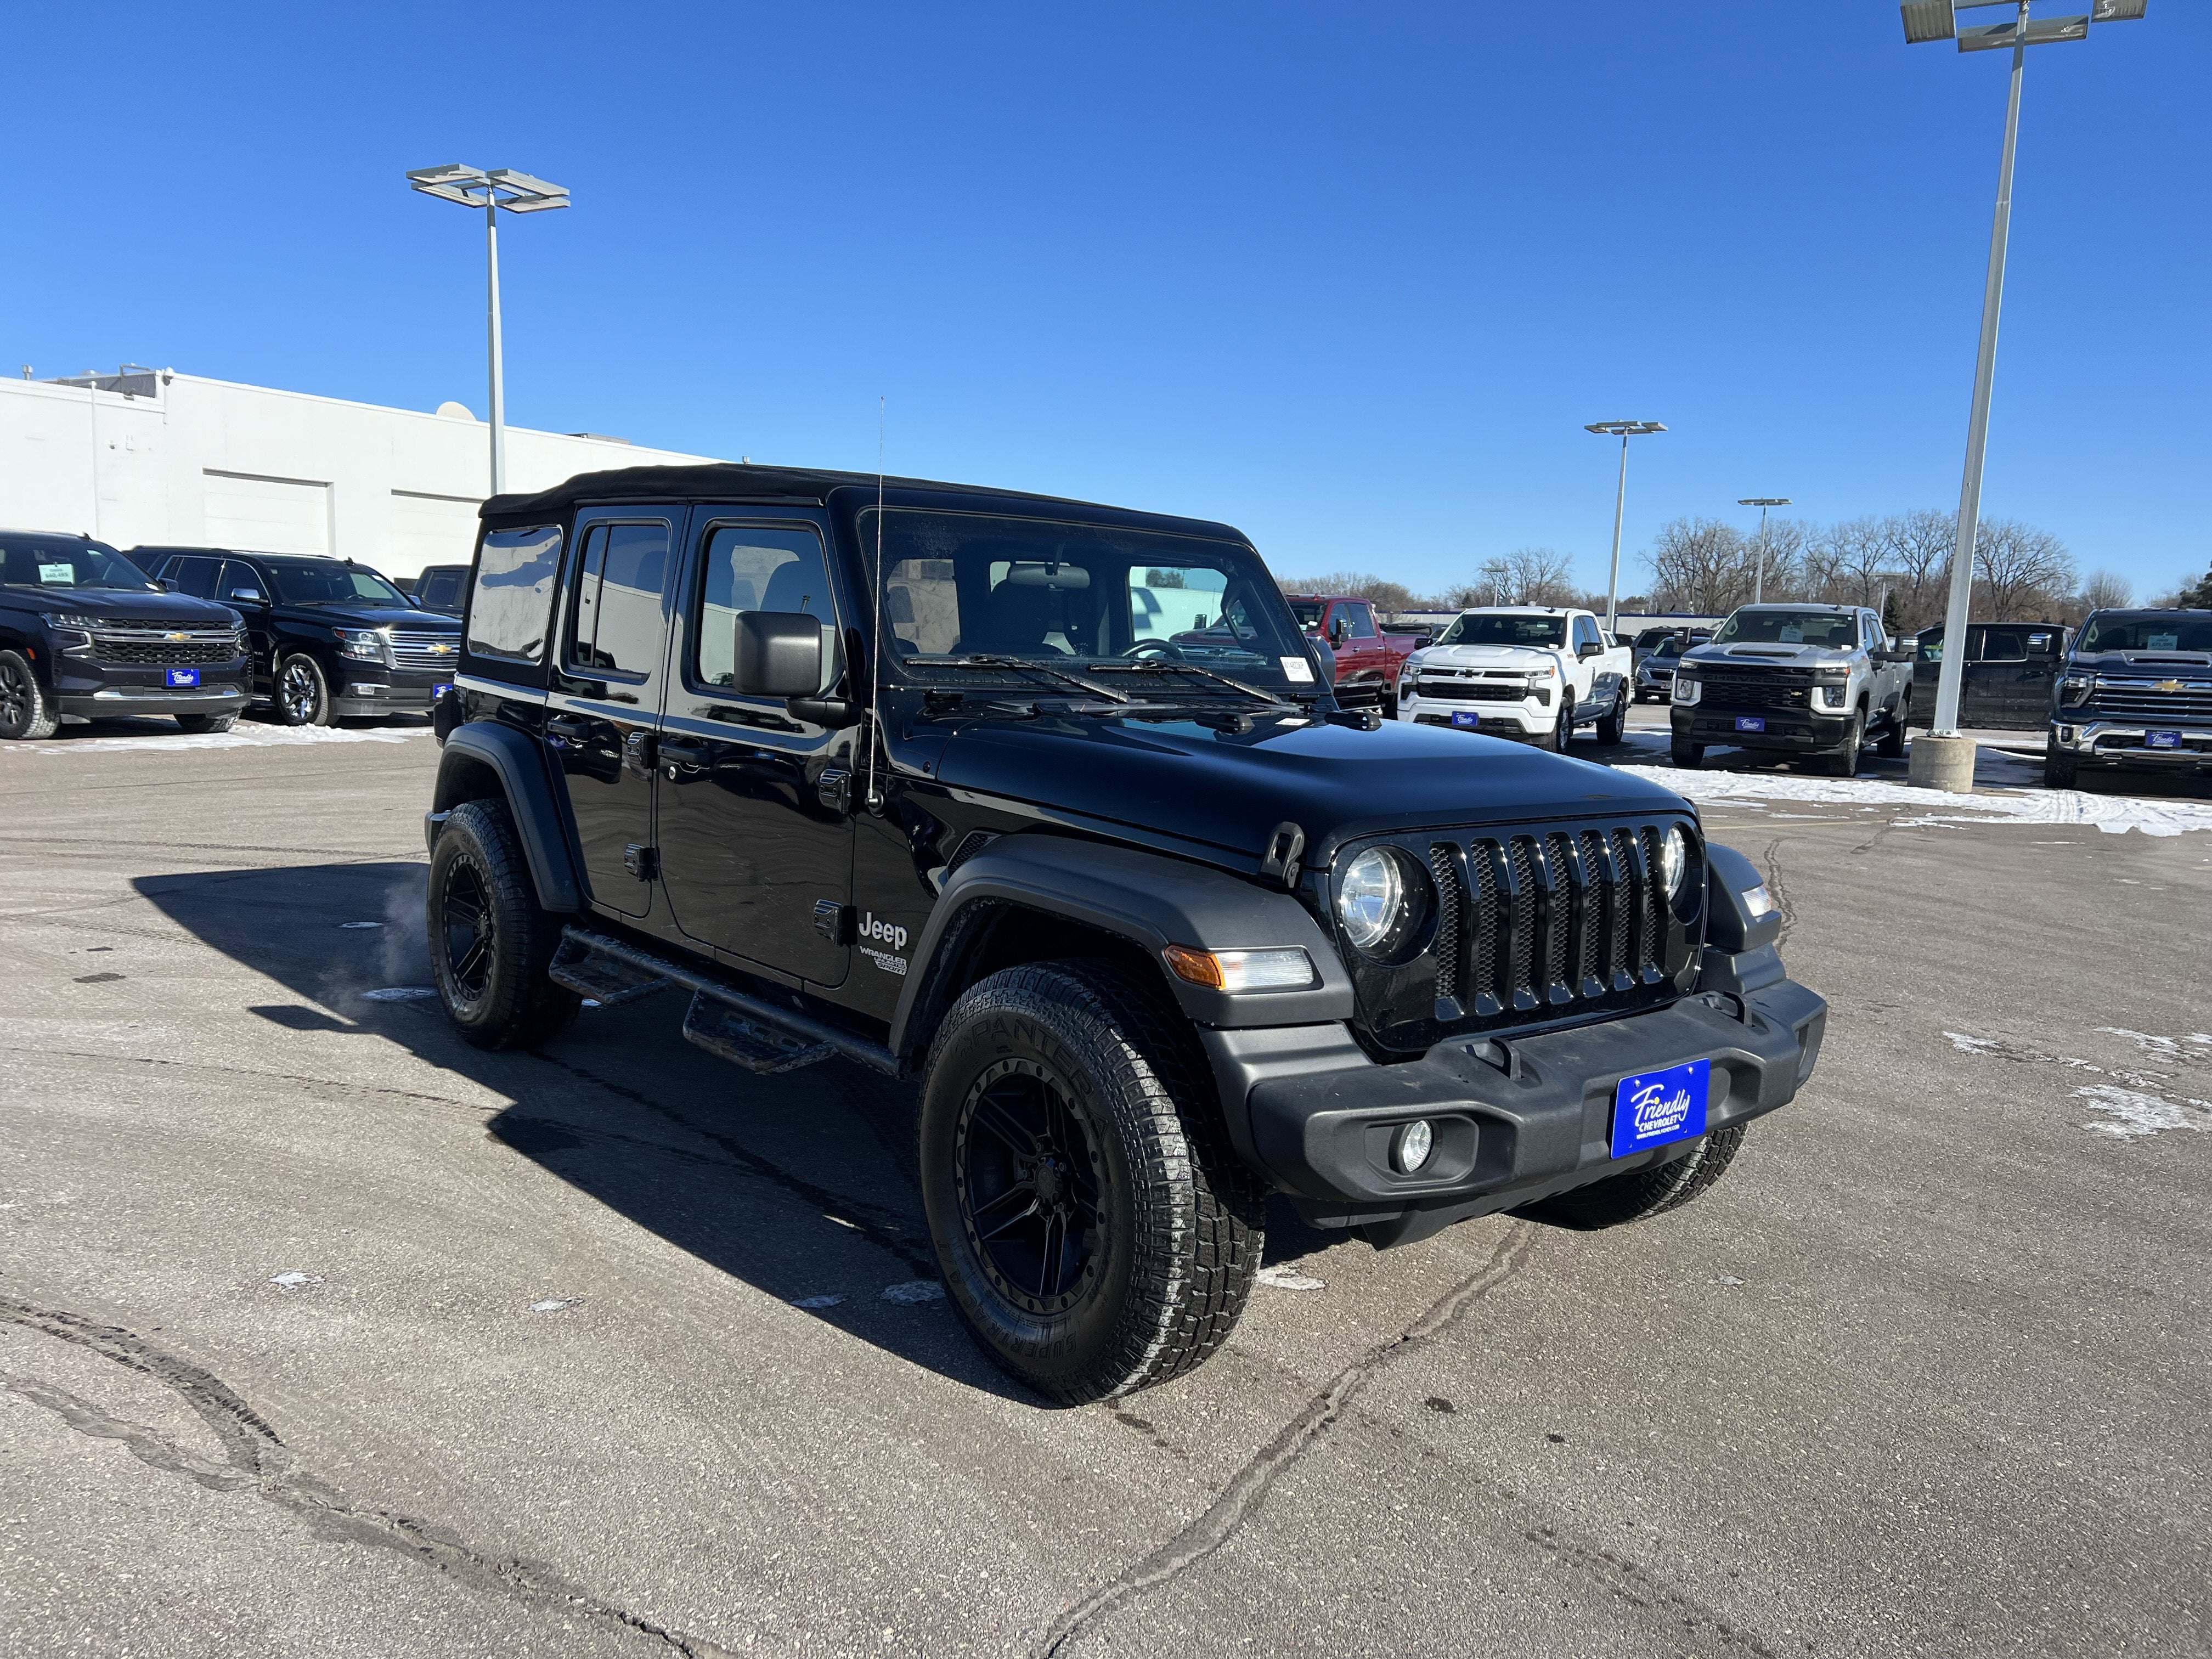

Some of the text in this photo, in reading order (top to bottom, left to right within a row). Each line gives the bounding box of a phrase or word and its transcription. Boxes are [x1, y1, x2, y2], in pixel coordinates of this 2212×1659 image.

[1703, 674, 1810, 685] CHEVROLET
[859, 911, 908, 950] Jeep
[859, 945, 907, 966] WRANGLER
[873, 956, 907, 969] UNLIMITED
[877, 962, 906, 974] SPORT
[972, 1015, 1108, 1146] PANTERA
[1630, 1084, 1690, 1127] Friendly
[1639, 1114, 1679, 1132] CHEVROLET
